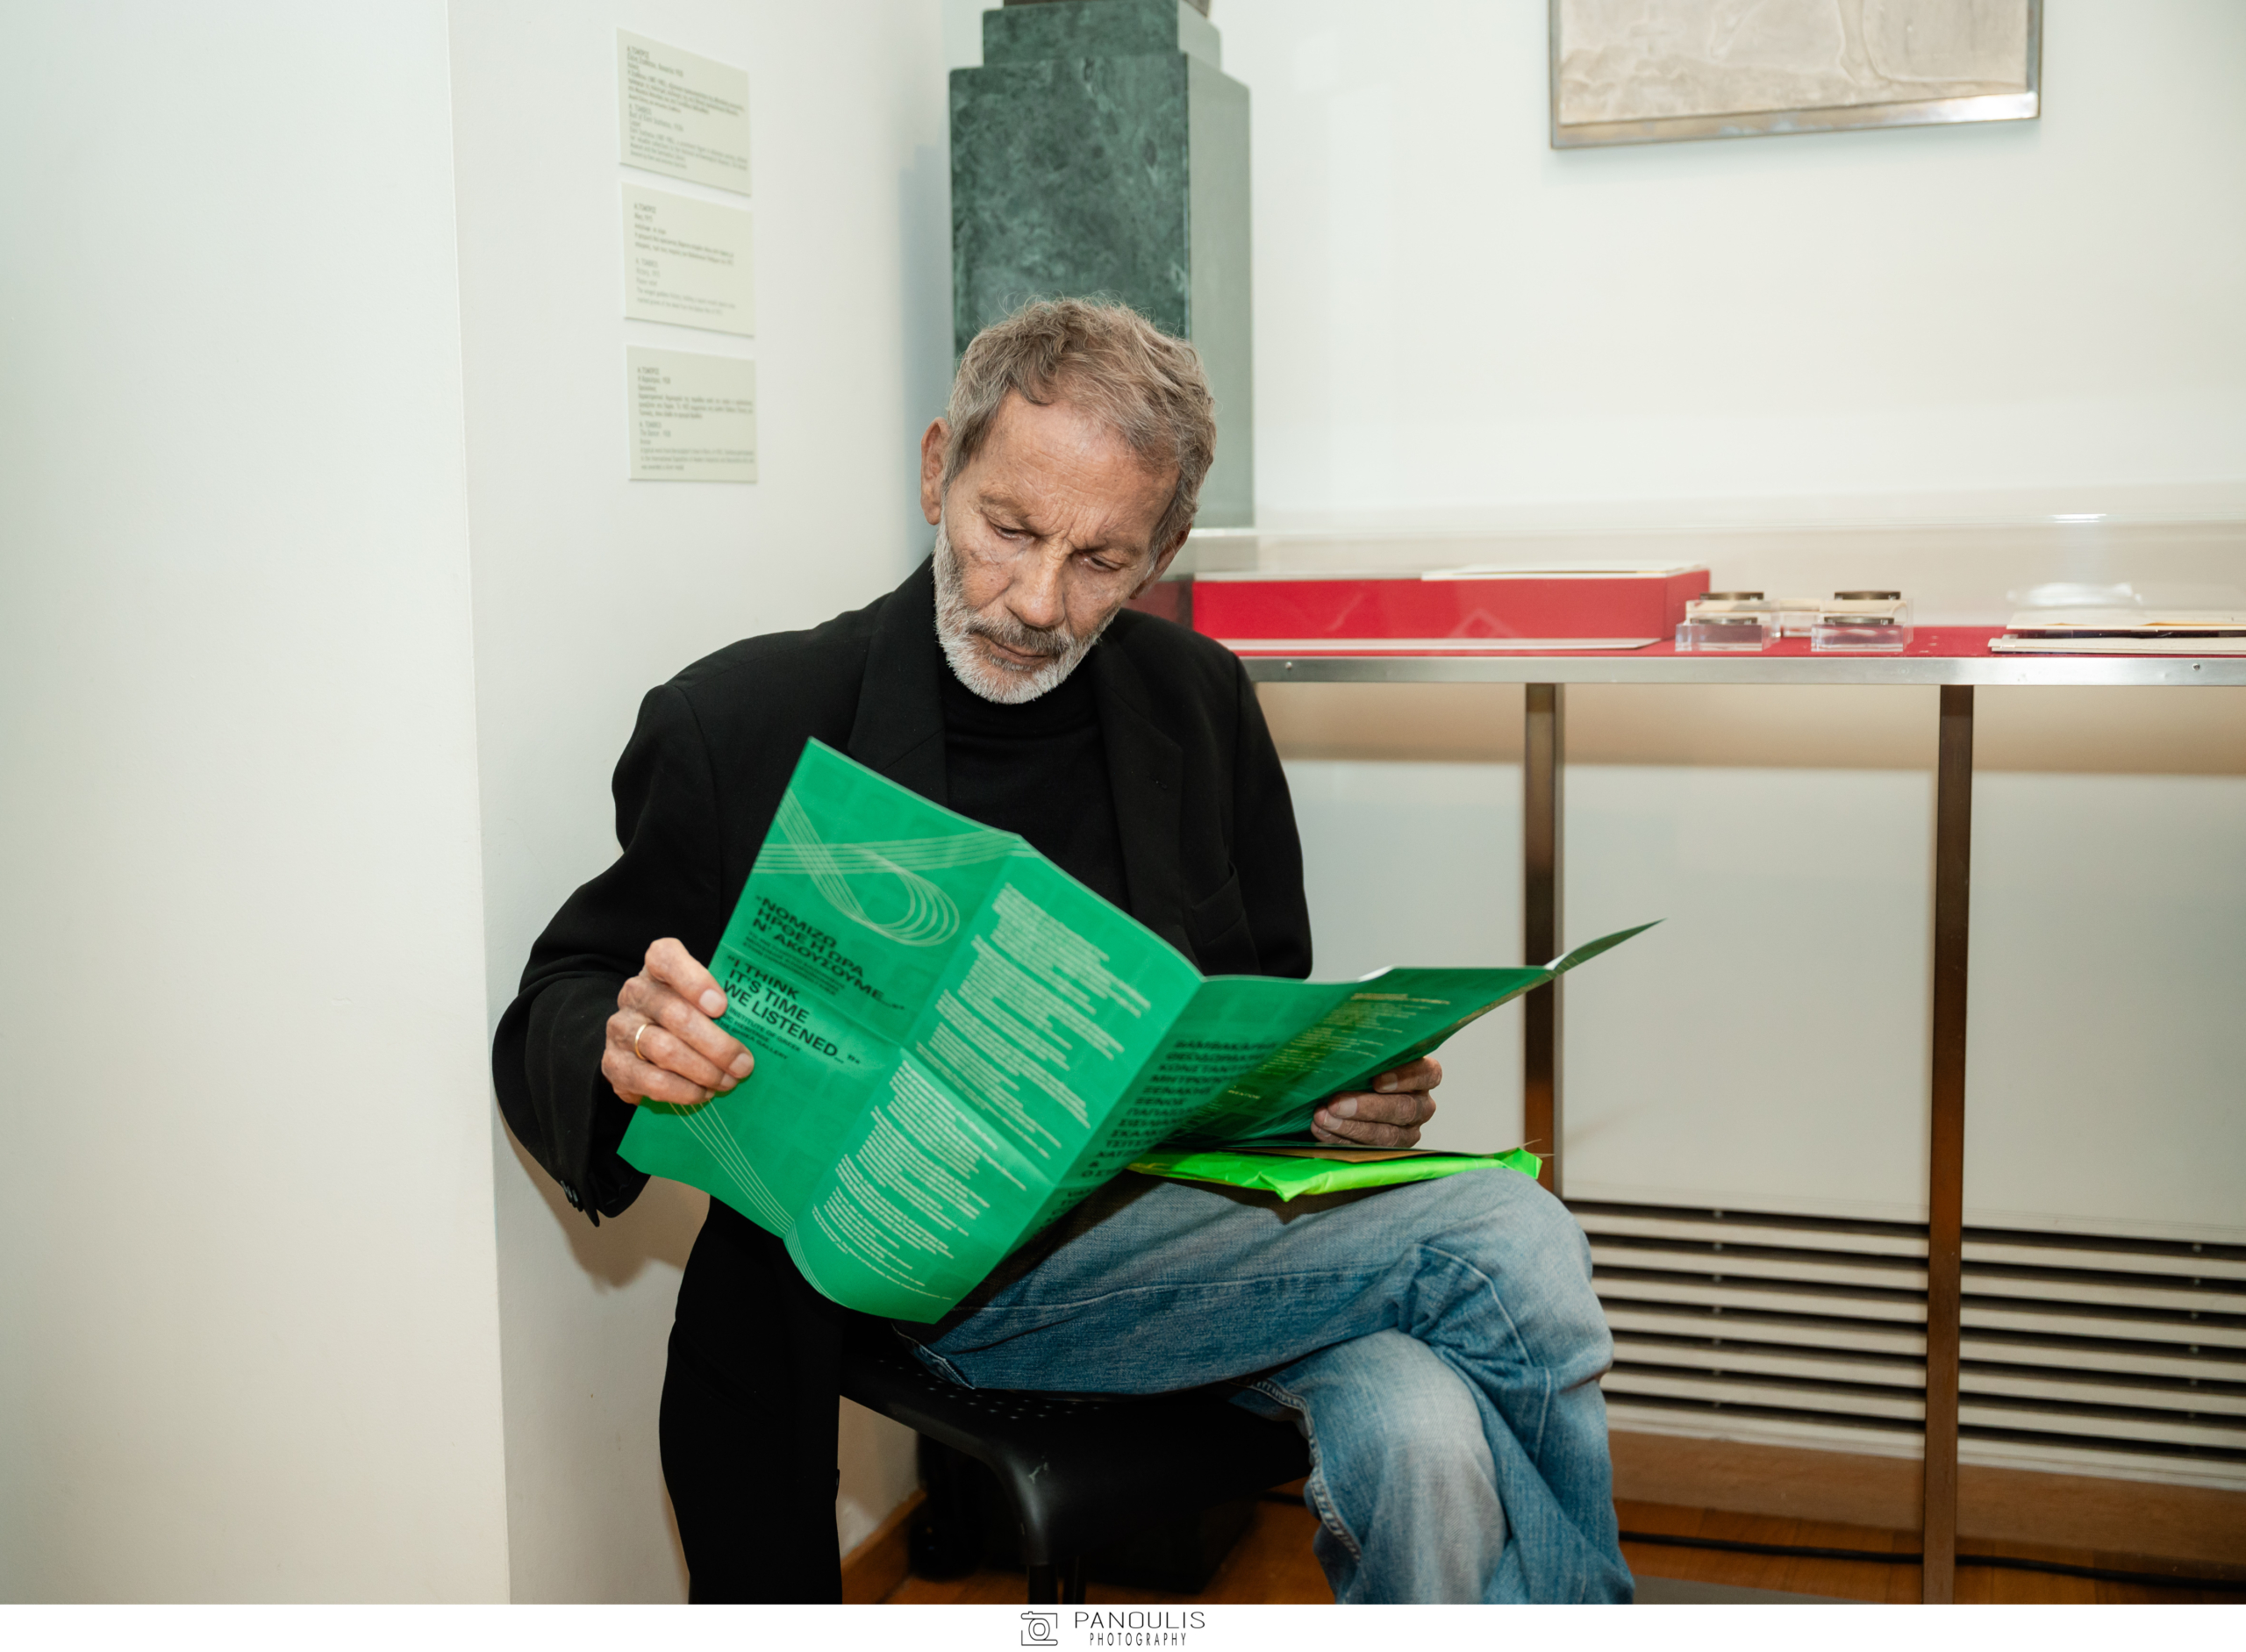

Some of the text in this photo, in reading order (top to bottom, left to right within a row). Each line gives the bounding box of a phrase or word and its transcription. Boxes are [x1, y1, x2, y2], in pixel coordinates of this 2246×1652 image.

[724, 979, 752, 1007] WE
[746, 963, 800, 1000] THINK
[726, 1006, 766, 1033] INSTITUTE
[764, 1028, 776, 1037] OF
[765, 987, 810, 1024] TIME
